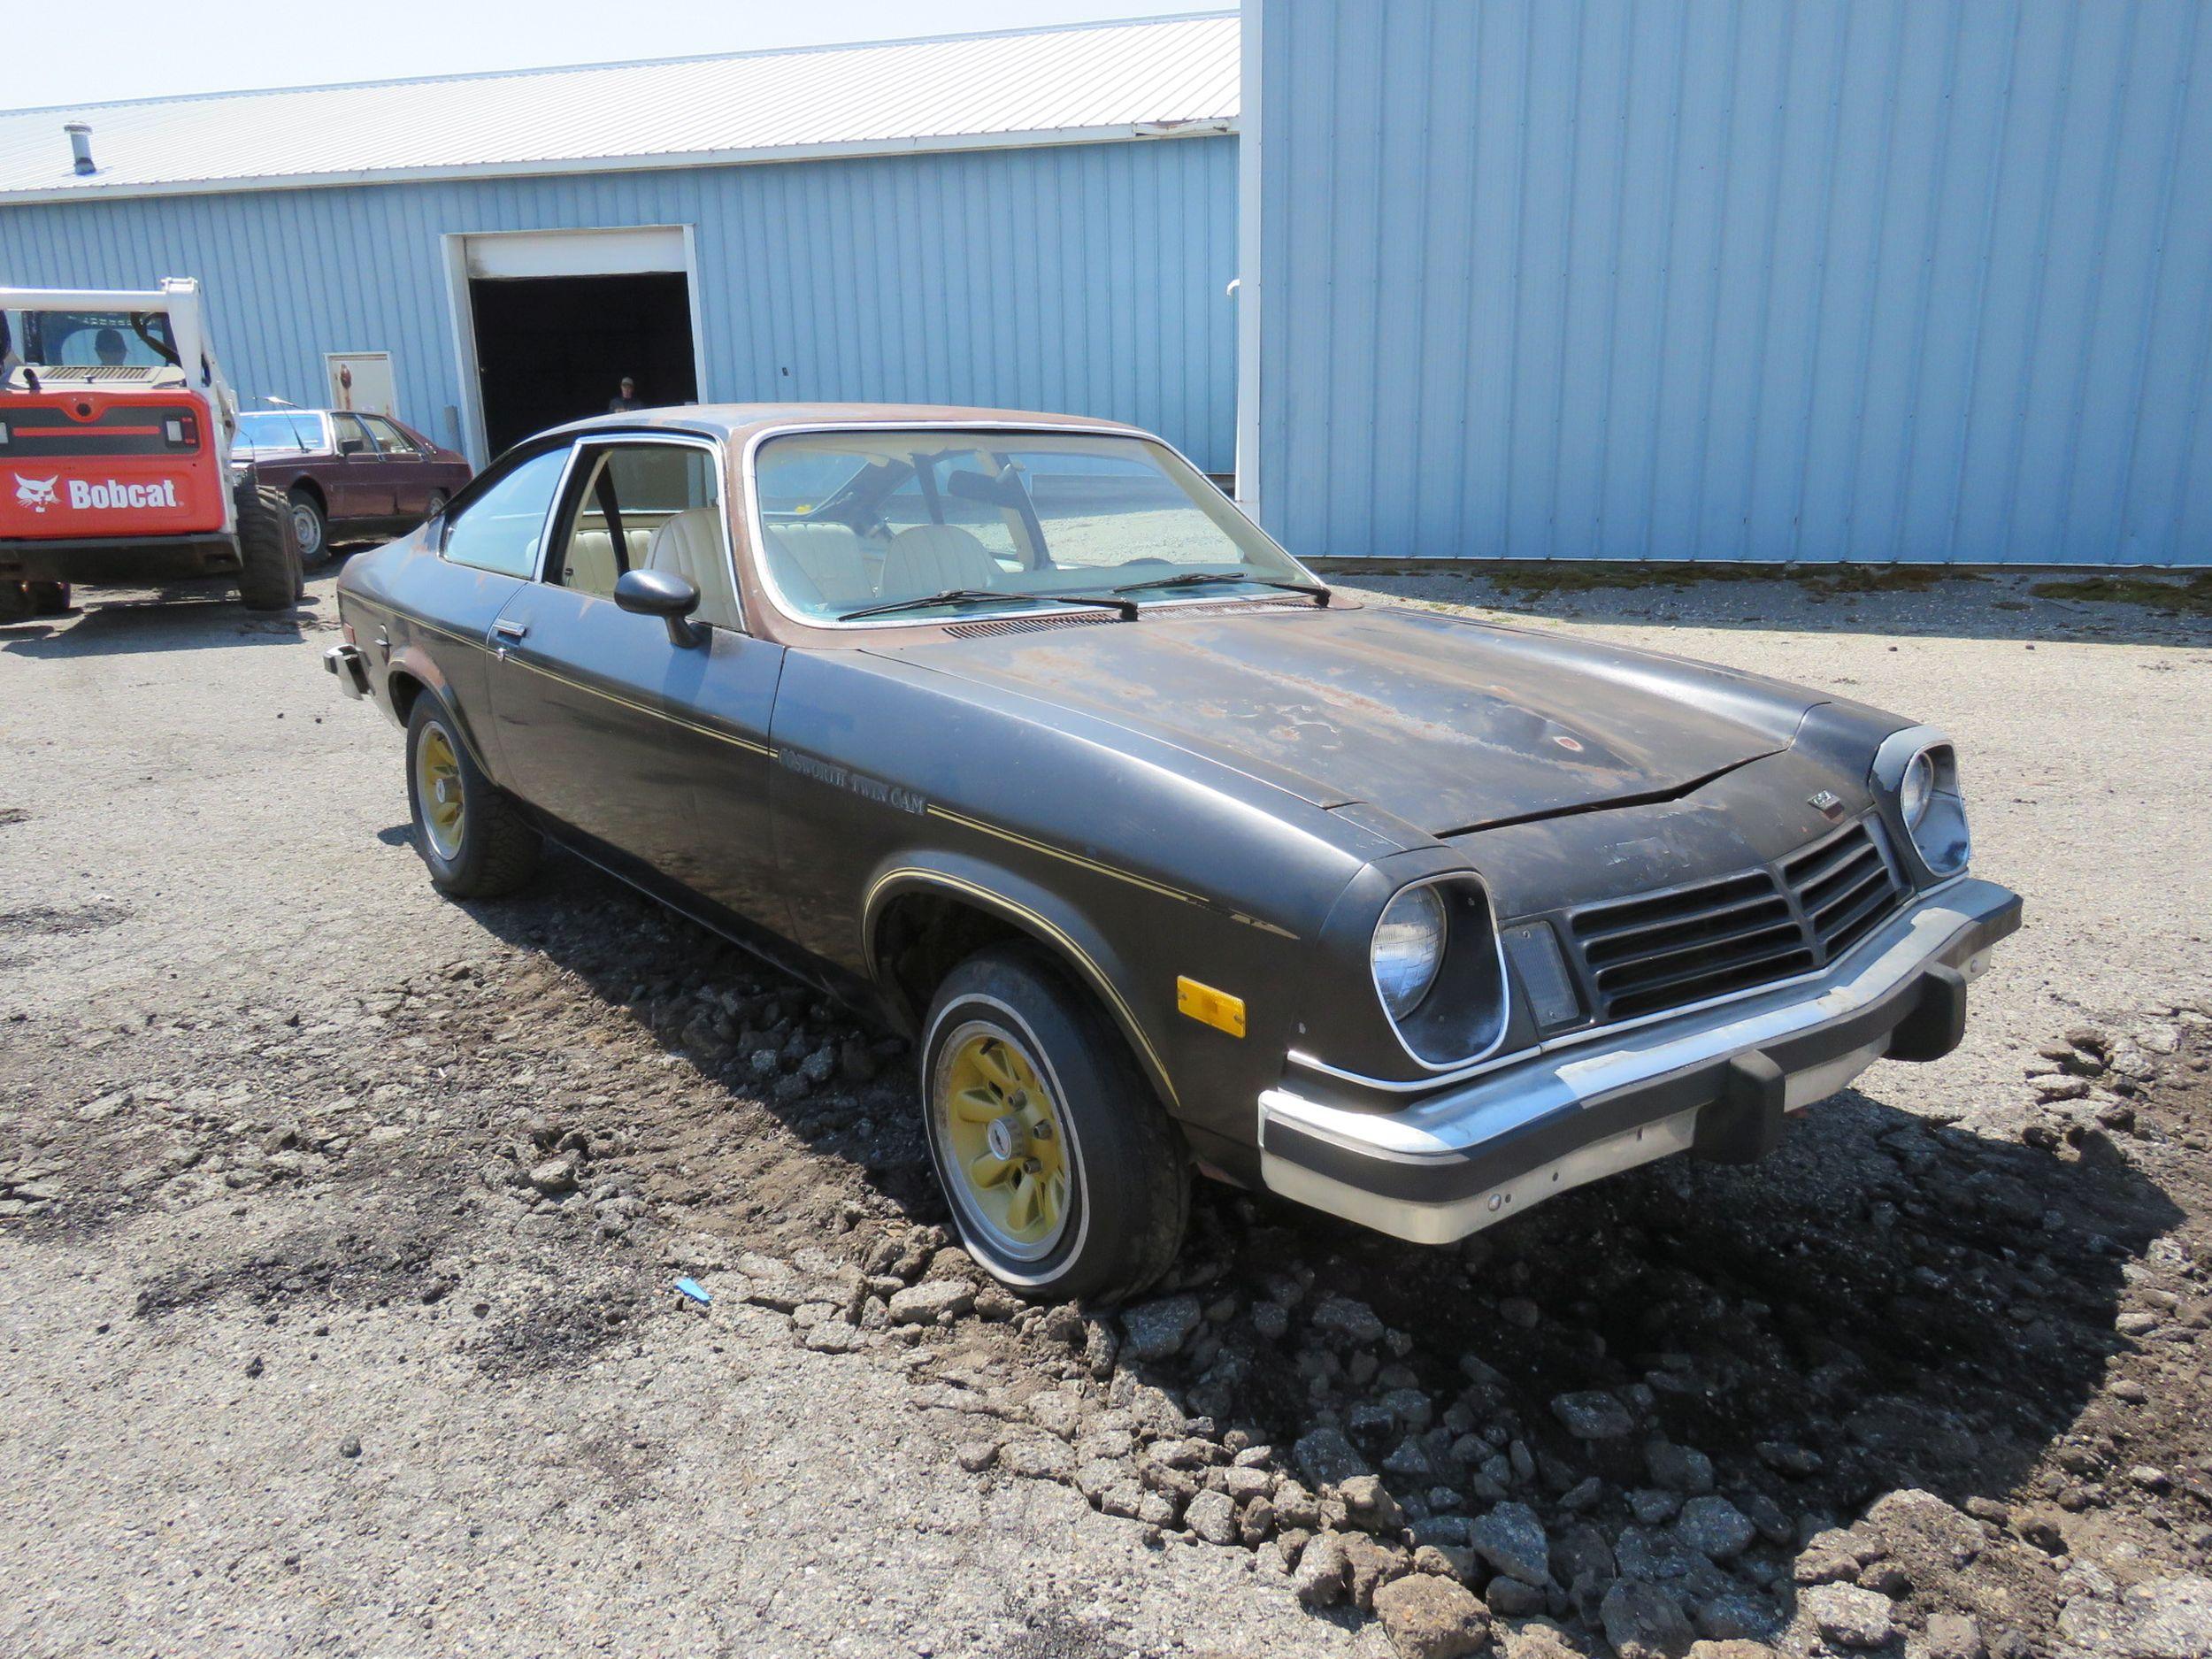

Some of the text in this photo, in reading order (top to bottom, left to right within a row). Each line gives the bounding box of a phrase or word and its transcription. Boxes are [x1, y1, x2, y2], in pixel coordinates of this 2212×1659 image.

[69, 480, 177, 509] Bobcat
[779, 748, 926, 815] COSWORTH TWIN CAM
